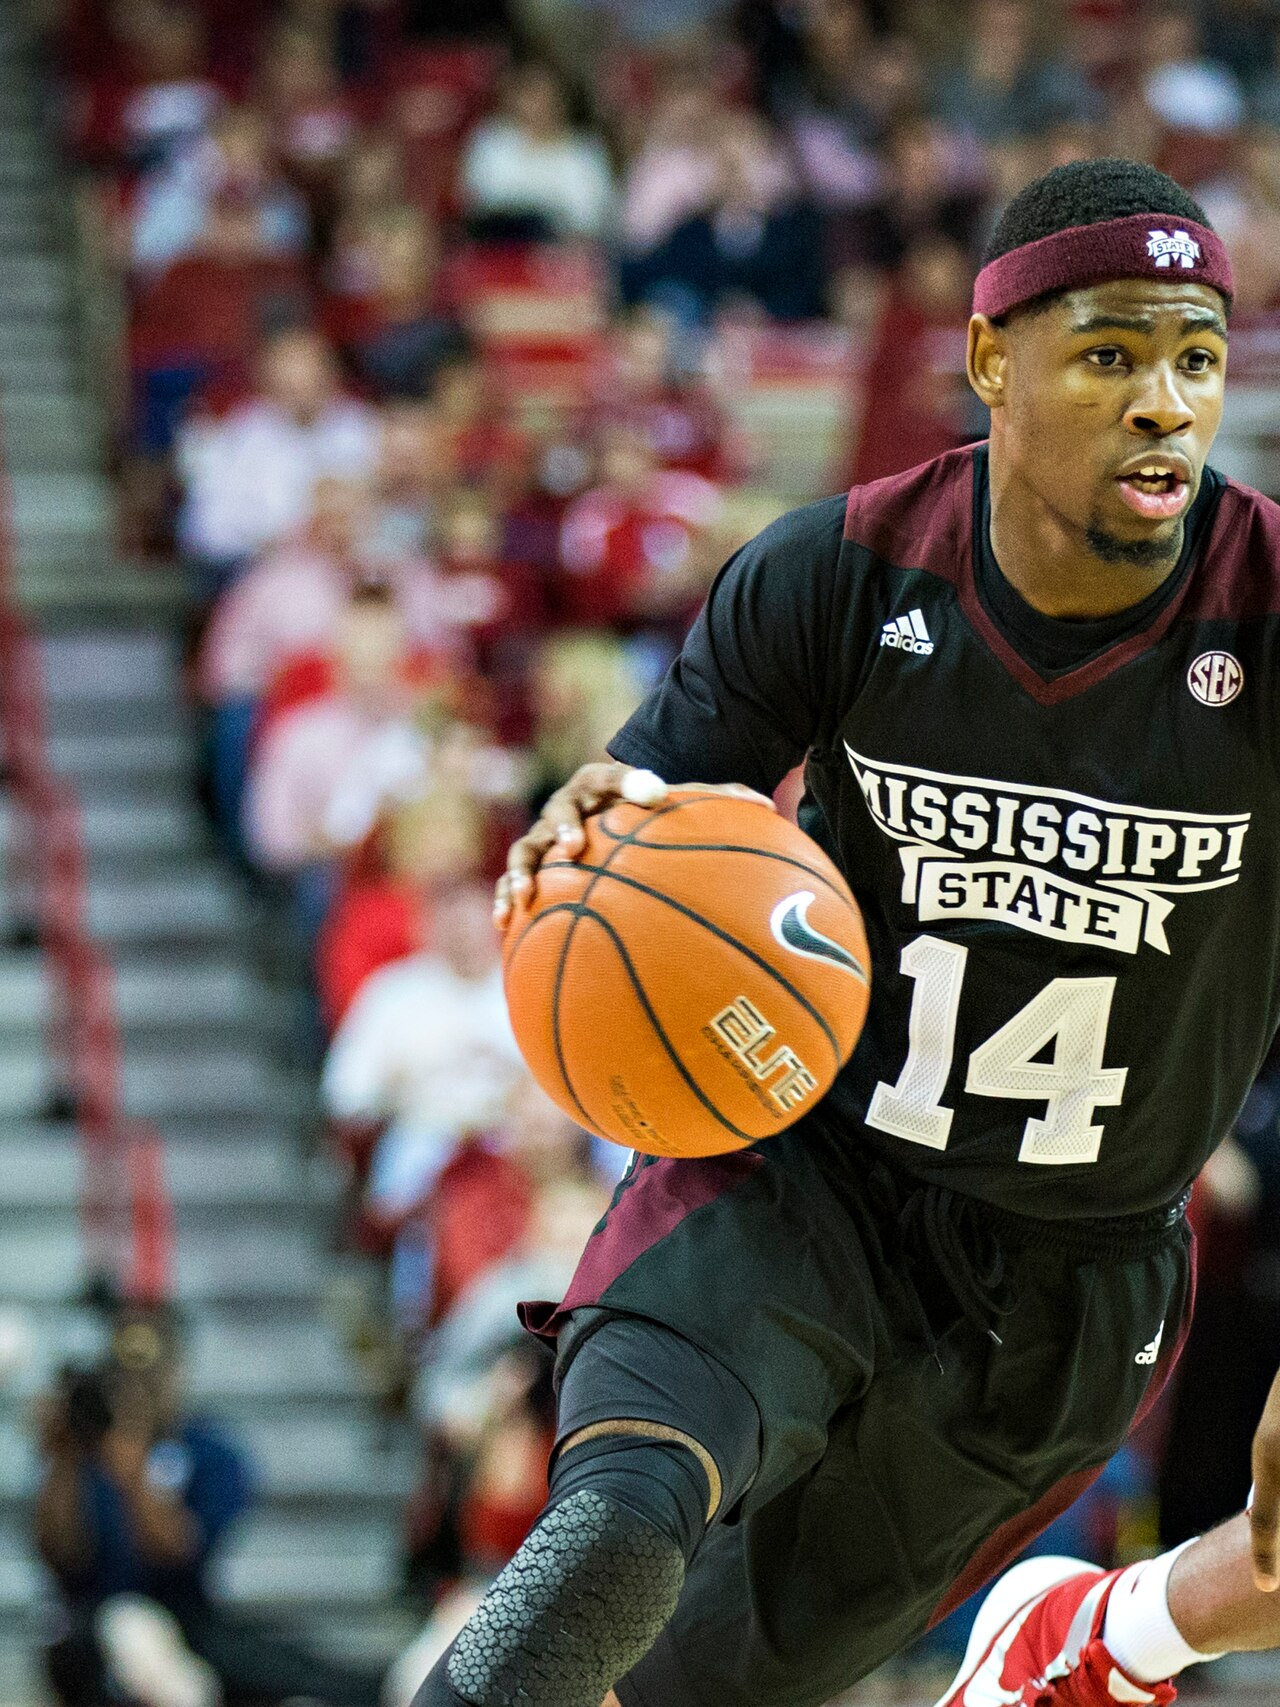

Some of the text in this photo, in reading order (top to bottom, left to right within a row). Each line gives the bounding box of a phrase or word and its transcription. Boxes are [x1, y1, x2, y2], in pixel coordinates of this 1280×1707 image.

[1156, 240, 1191, 254] STATE
[1191, 654, 1240, 702] SEC
[860, 769, 1250, 878] MISSISSIPPI
[937, 871, 1120, 941] STATE
[709, 995, 819, 1112] ELITE
[865, 935, 1130, 1166] 14
